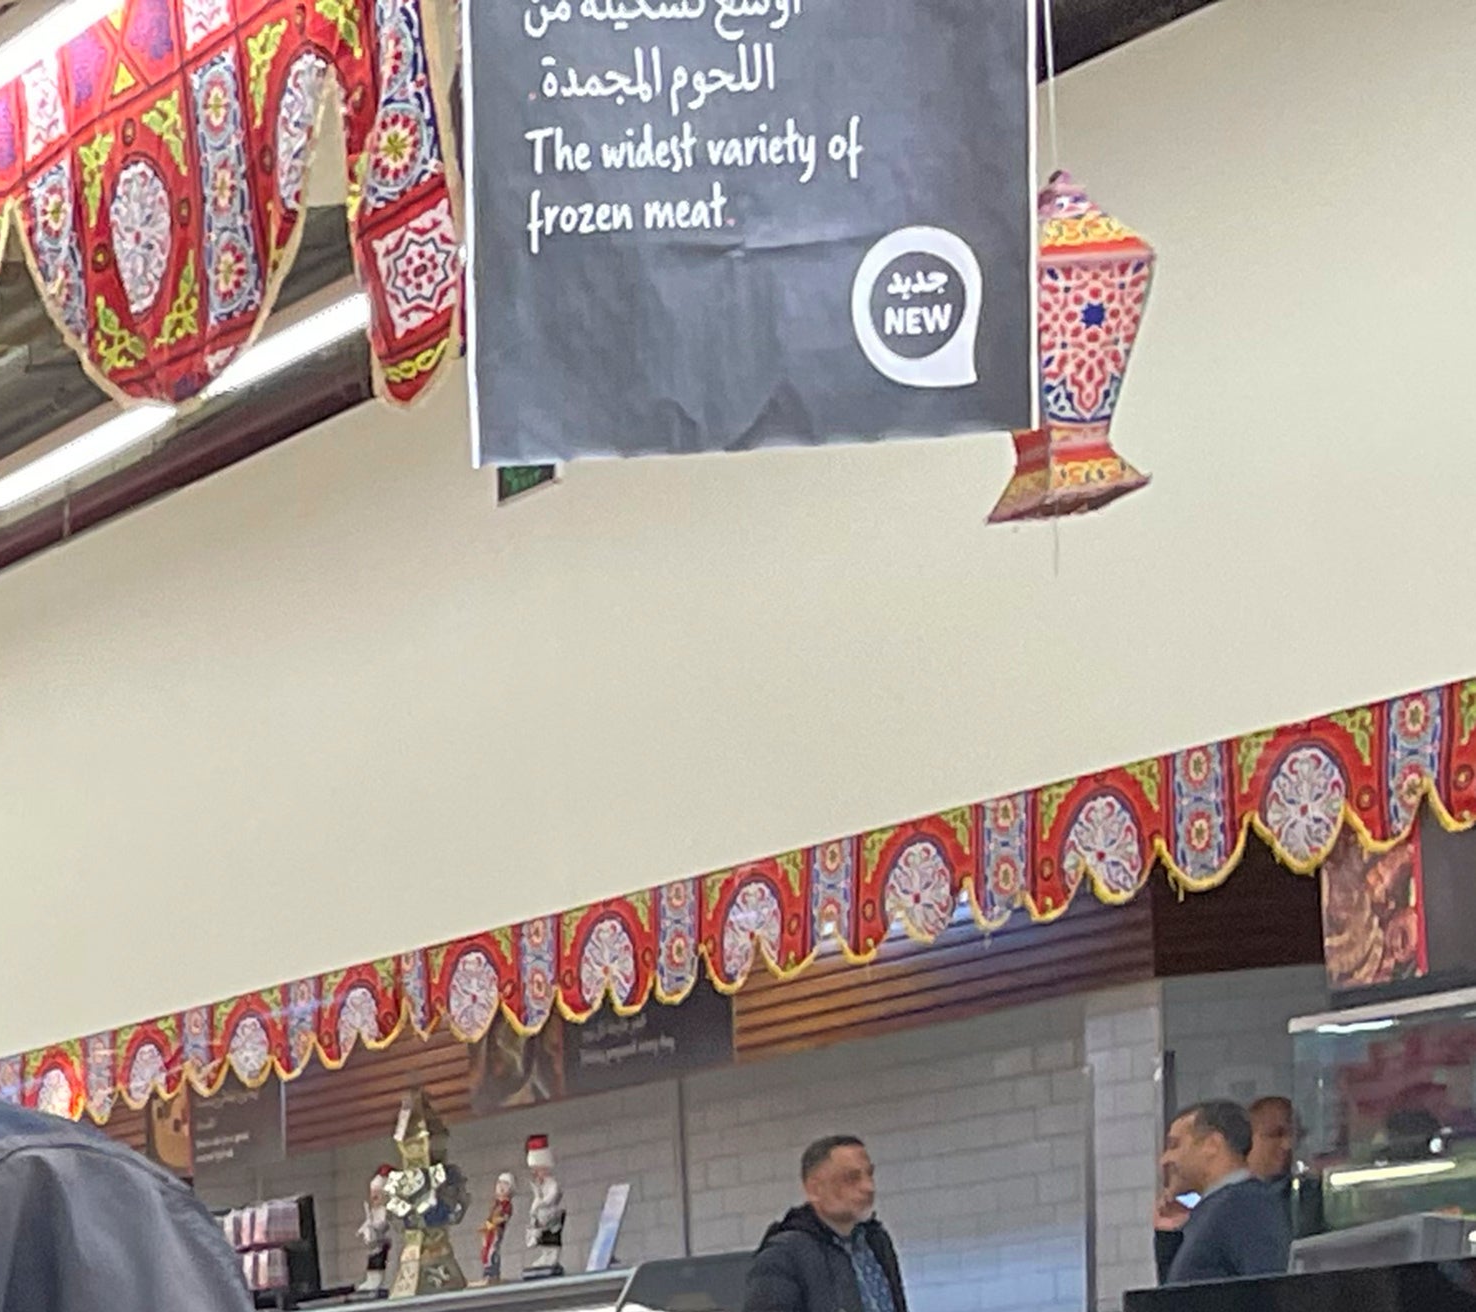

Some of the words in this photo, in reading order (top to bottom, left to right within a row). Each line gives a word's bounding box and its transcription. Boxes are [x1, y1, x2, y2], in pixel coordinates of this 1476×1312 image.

[670, 42, 775, 116] اللحوم
[524, 126, 592, 174] The
[600, 121, 698, 172] widest
[707, 118, 816, 183] variety
[828, 115, 864, 180] of
[527, 190, 633, 254] frozen
[644, 181, 736, 230] meat.
[884, 303, 952, 335] NEW
[887, 270, 948, 300] جديد
